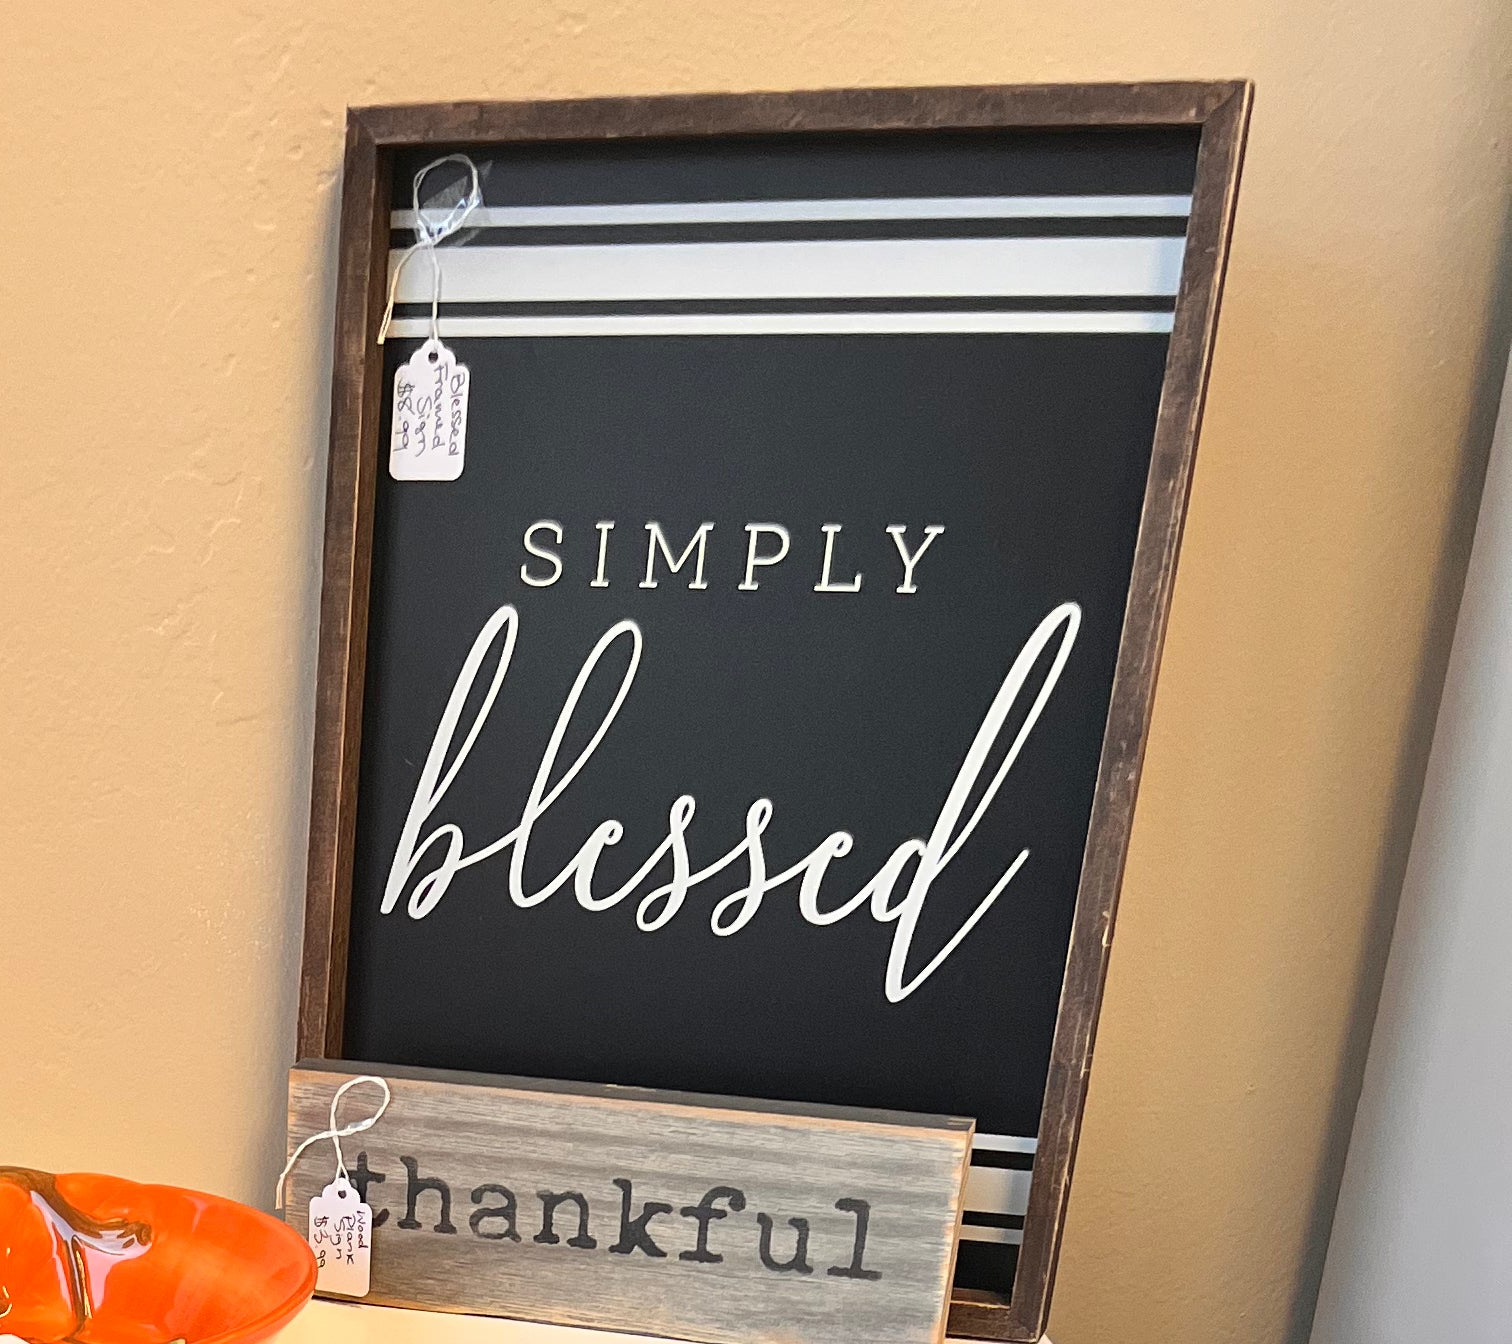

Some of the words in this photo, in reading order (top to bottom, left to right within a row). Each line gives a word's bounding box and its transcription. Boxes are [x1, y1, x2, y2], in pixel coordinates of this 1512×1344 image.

[519, 521, 945, 595] SIMPLY
[380, 601, 1083, 1004] blessed
[341, 1151, 882, 1282] thankful
